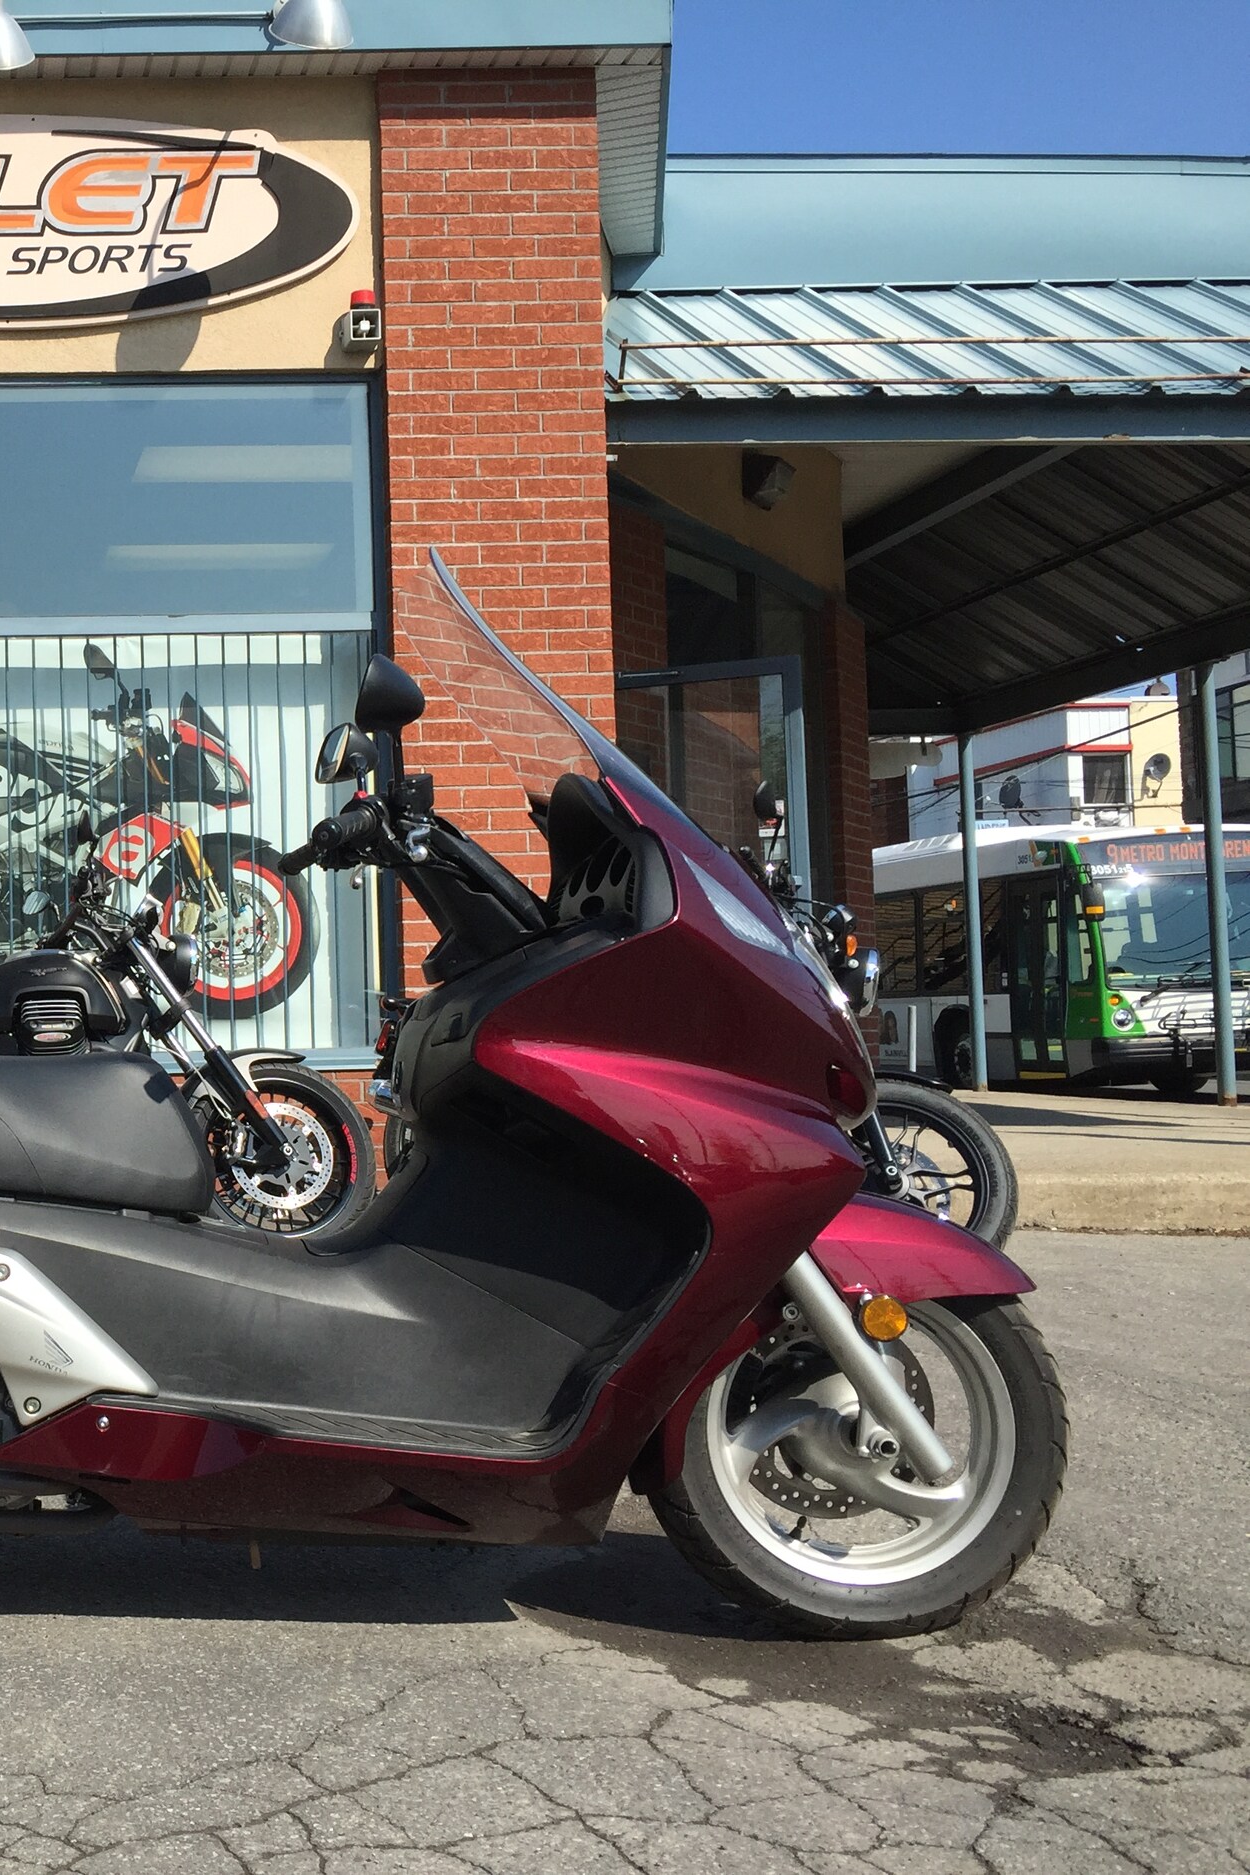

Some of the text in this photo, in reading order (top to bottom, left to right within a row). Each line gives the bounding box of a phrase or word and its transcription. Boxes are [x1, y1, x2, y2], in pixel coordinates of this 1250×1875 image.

[6, 243, 193, 275] SPORTS
[1106, 844, 1117, 865] 9
[1120, 843, 1165, 863] METRO
[29, 1355, 68, 1377] HONDA
